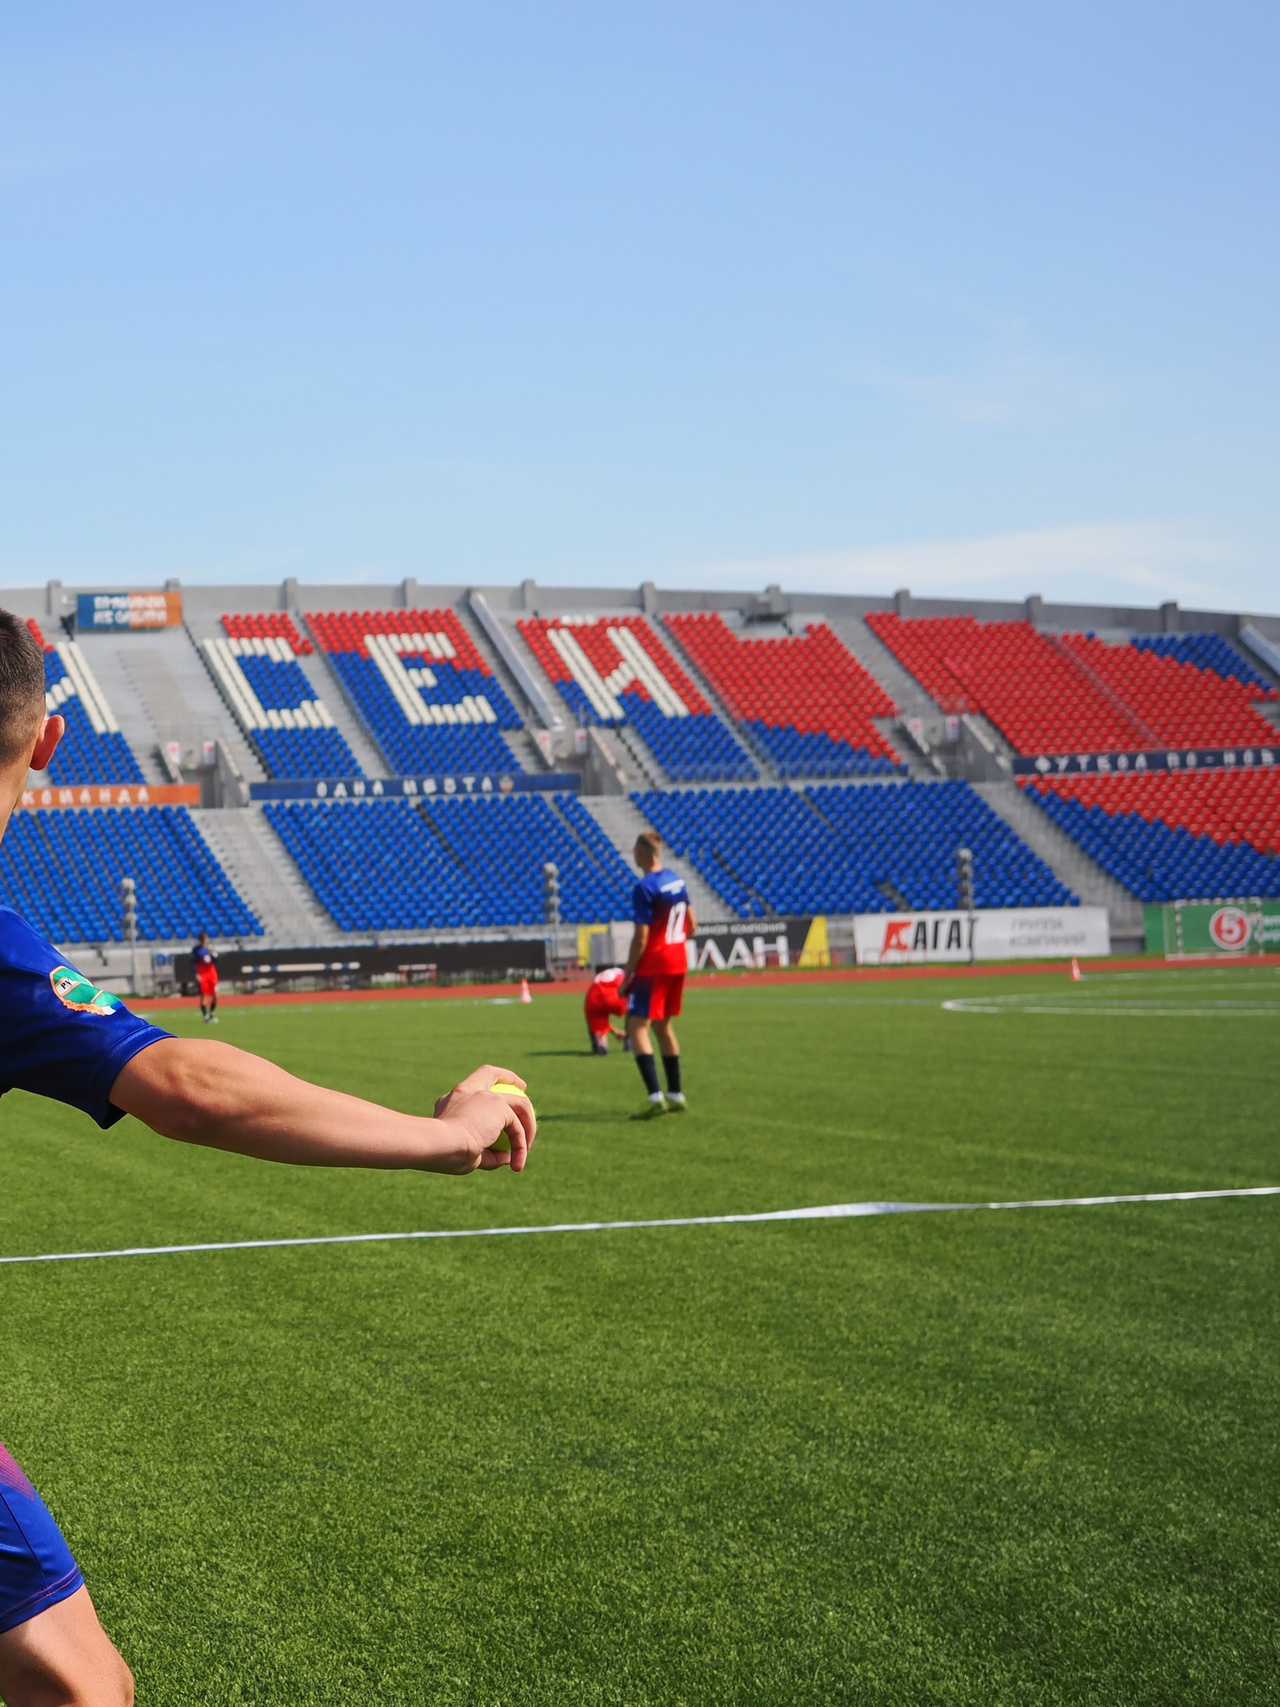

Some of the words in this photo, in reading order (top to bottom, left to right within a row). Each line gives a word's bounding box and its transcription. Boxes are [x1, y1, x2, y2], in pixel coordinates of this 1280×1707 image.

[1034, 753, 1148, 774] ФУТБОЛ
[21, 787, 151, 806] КОМАНДА
[316, 779, 385, 798] ОДНА
[665, 901, 687, 944] 12
